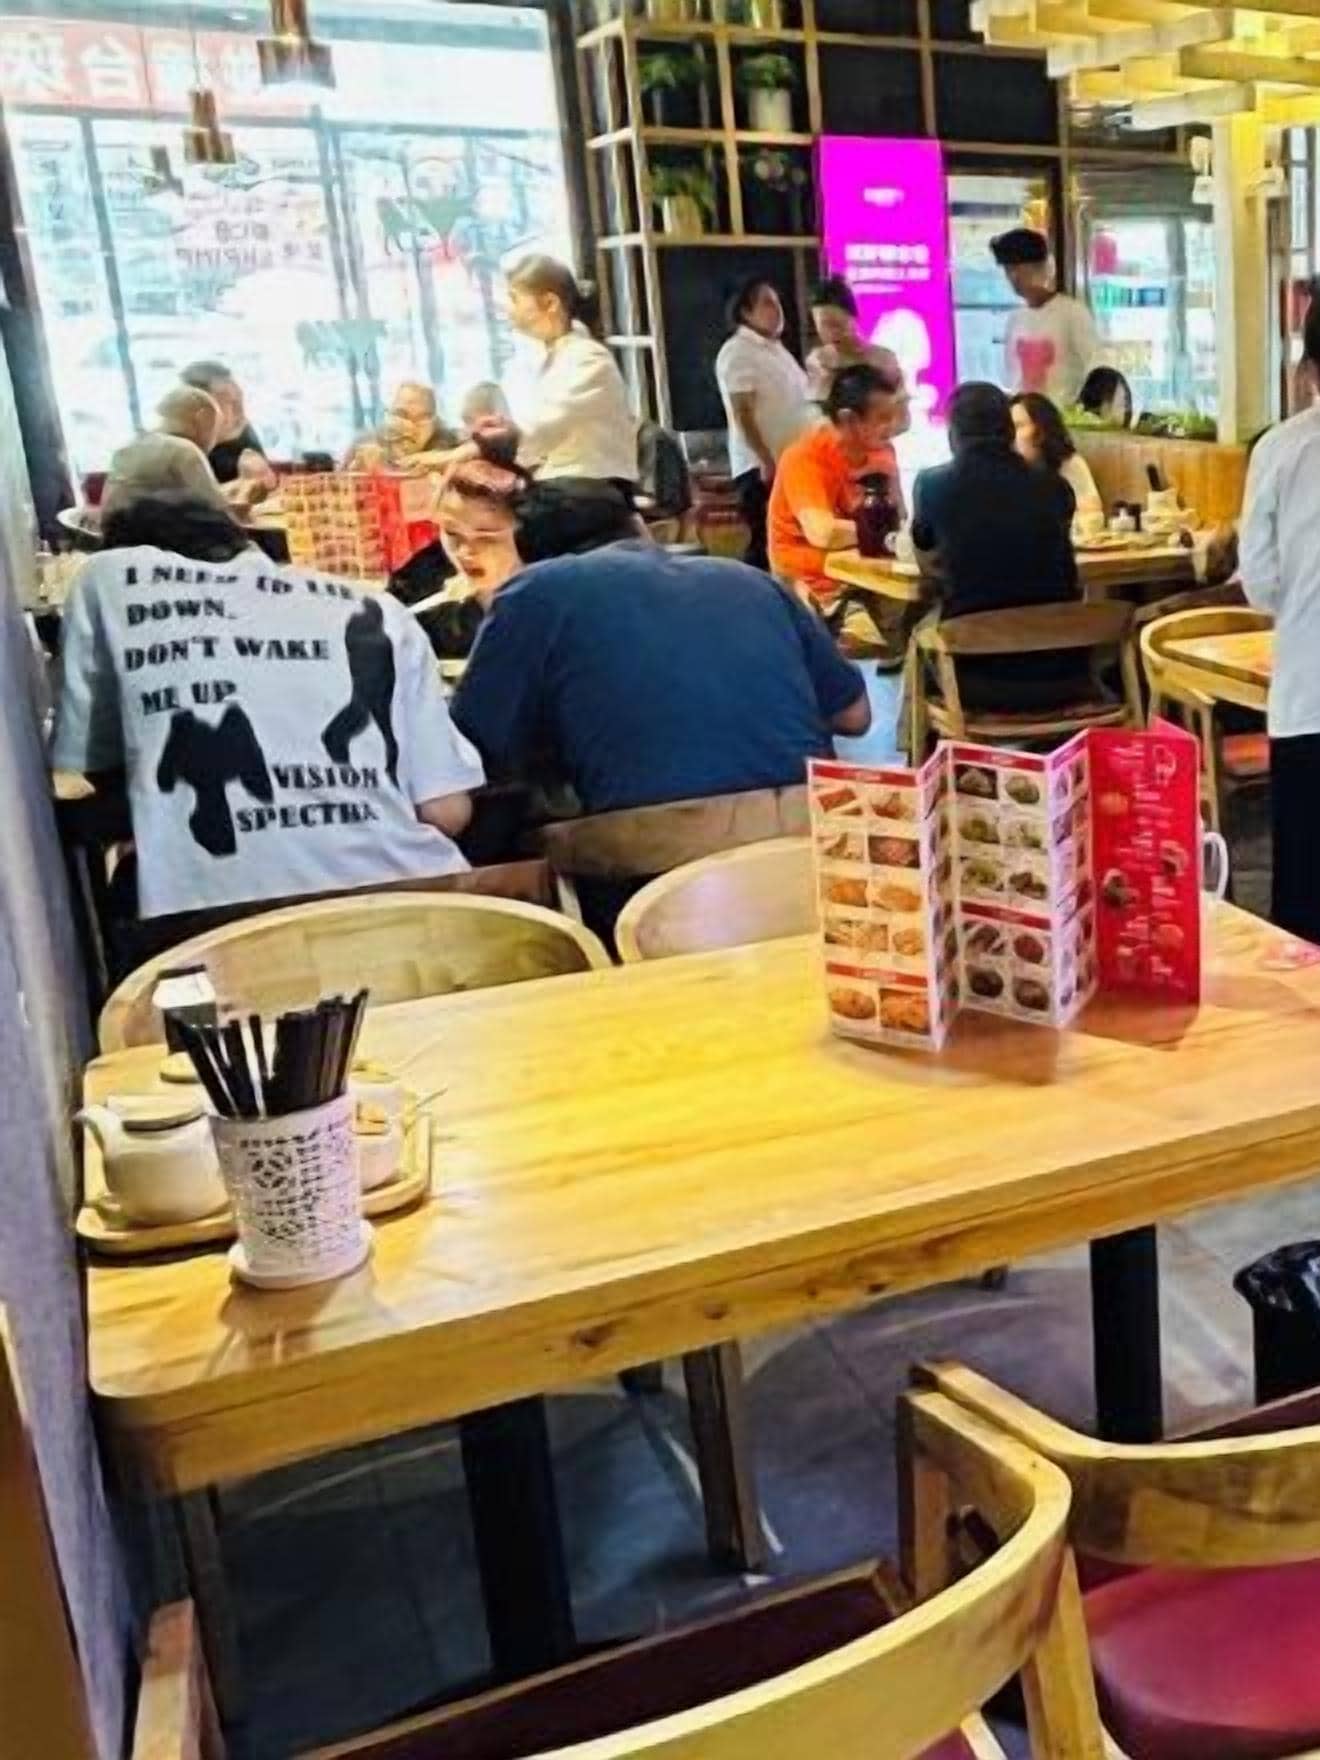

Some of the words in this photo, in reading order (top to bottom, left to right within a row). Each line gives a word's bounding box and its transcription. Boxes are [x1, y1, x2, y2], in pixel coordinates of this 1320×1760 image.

[124, 636, 220, 672] DON'T
[234, 637, 331, 661] WAKE
[140, 685, 181, 716] ME
[191, 679, 238, 705] UP
